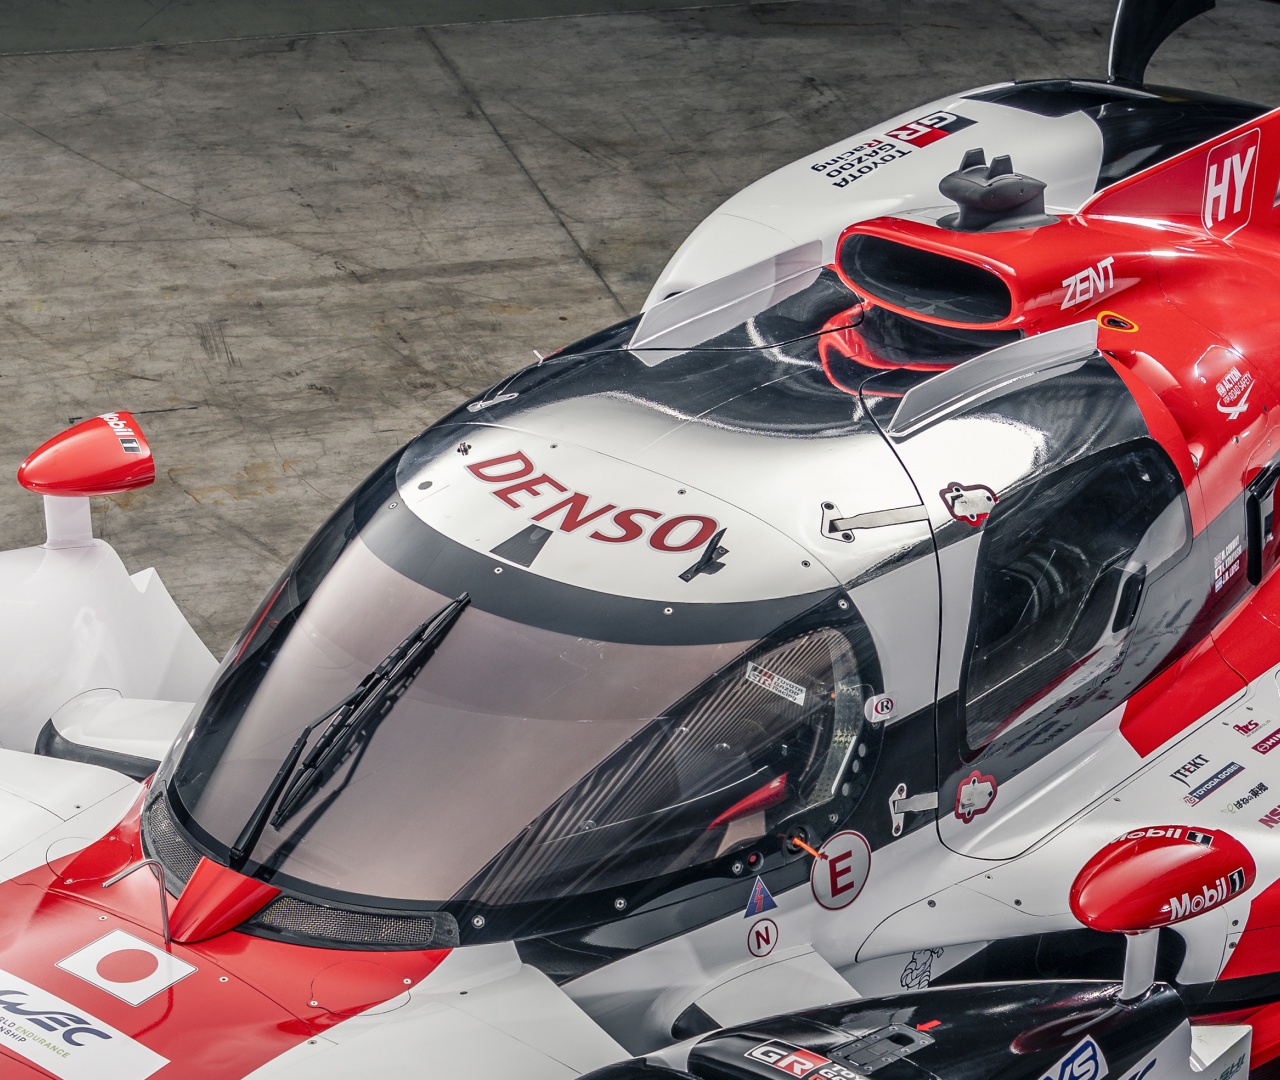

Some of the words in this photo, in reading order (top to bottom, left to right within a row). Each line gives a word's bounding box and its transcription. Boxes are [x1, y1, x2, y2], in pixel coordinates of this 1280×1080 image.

[811, 138, 884, 172] Racing
[826, 143, 897, 178] GAZOO
[832, 150, 912, 188] TOYOTA
[1205, 146, 1257, 229] HY
[1061, 256, 1115, 310] ZENT
[1222, 366, 1242, 391] ACTION
[466, 450, 718, 552] DENSO
[1169, 754, 1210, 788] JTEKT
[829, 849, 856, 899] E
[1169, 877, 1227, 920] Mobil
[754, 926, 771, 949] N
[14, 1025, 71, 1059] ENDURANCE
[750, 1045, 815, 1075] GR
